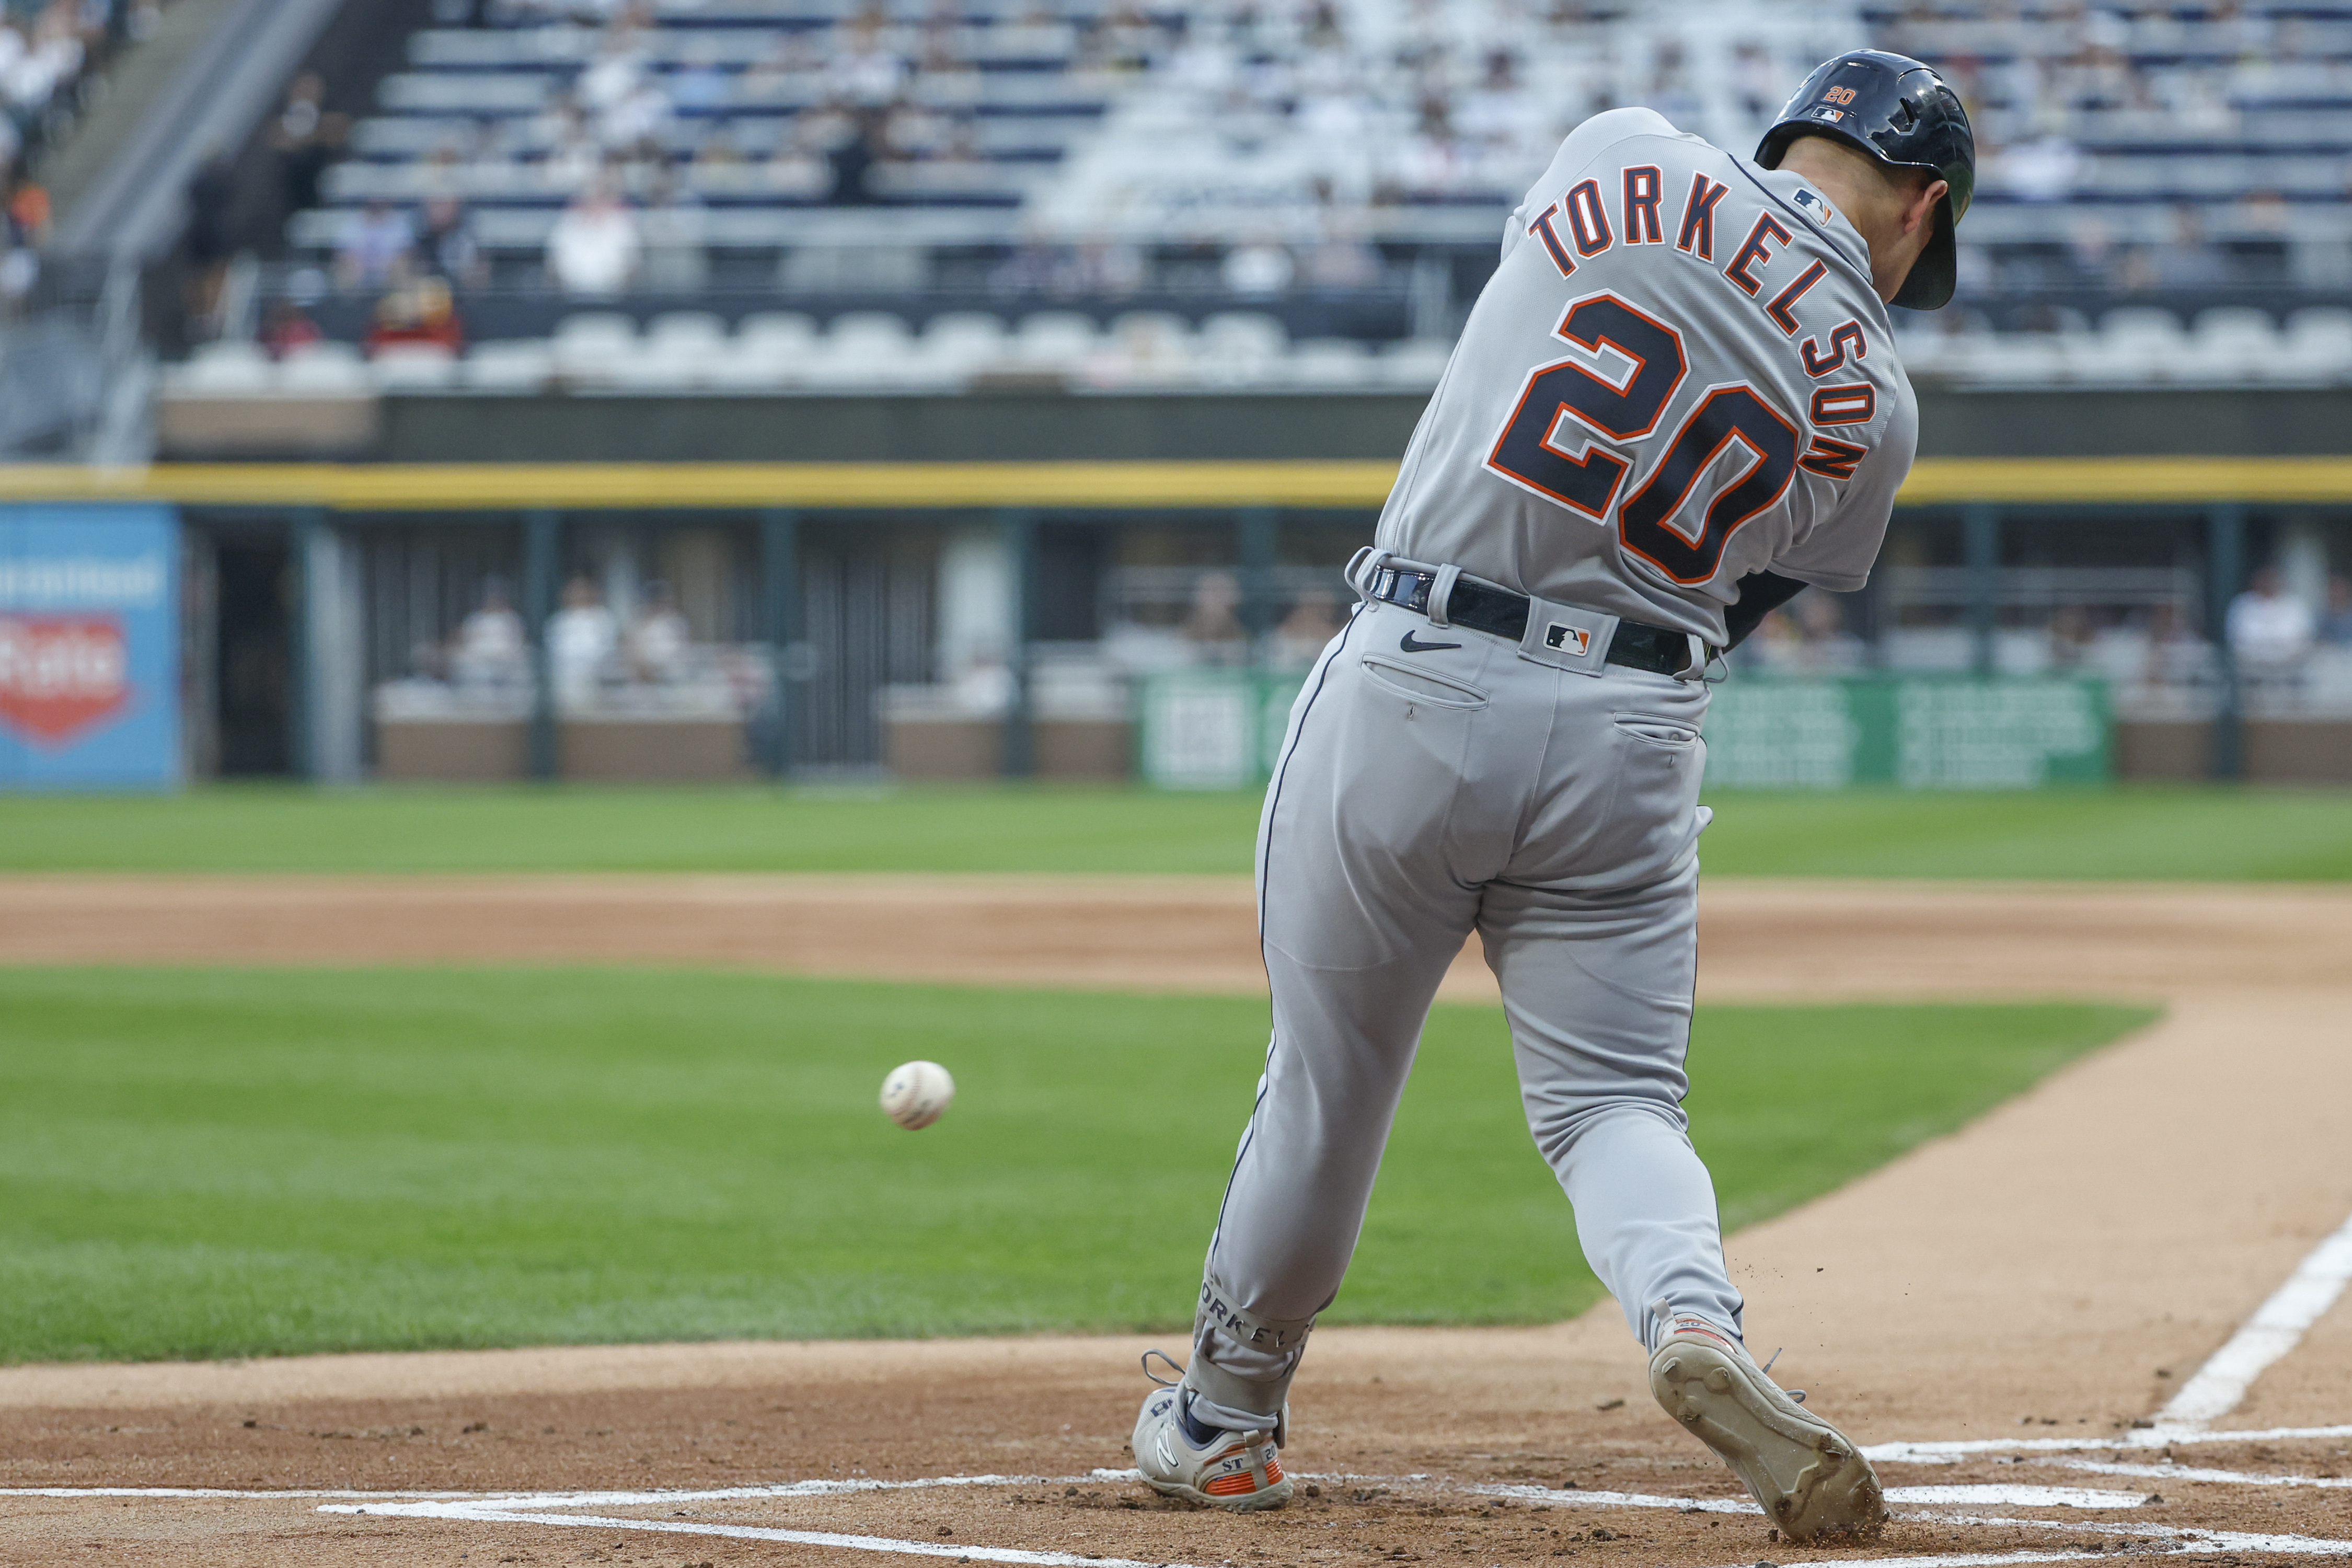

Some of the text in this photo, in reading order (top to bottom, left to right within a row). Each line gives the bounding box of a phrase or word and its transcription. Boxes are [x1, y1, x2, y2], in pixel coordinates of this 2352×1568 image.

[1824, 86, 1856, 105] 20
[1527, 165, 1876, 481] TORKELSON
[1482, 289, 1803, 587] 20
[1265, 1445, 1276, 1460] 20
[1222, 1458, 1243, 1472] ST
